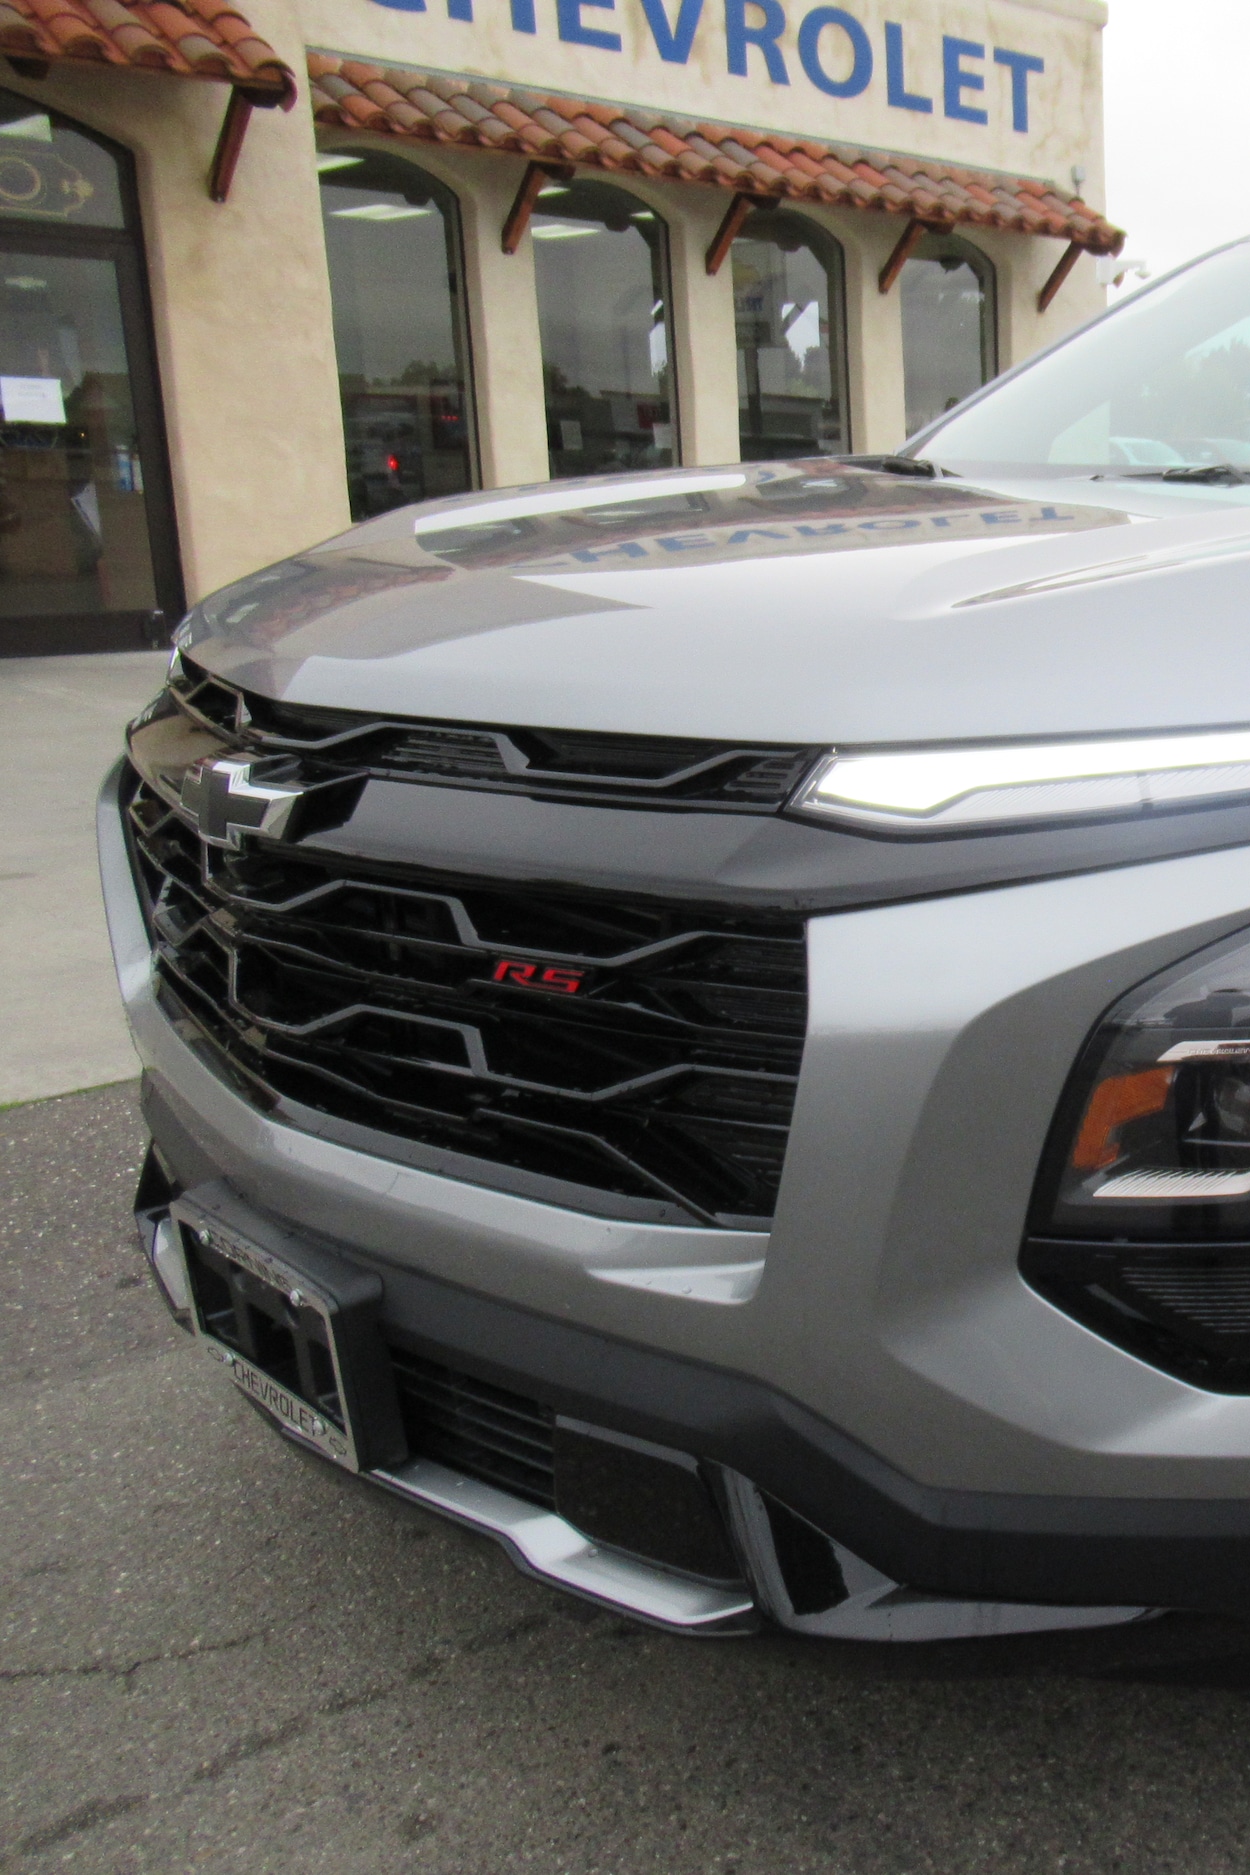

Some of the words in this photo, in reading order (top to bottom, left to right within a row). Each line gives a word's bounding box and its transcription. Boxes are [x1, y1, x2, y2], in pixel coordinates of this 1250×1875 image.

[368, 0, 1045, 133] EVROLET
[493, 960, 585, 993] RS
[232, 1361, 321, 1436] CHEVROLET
